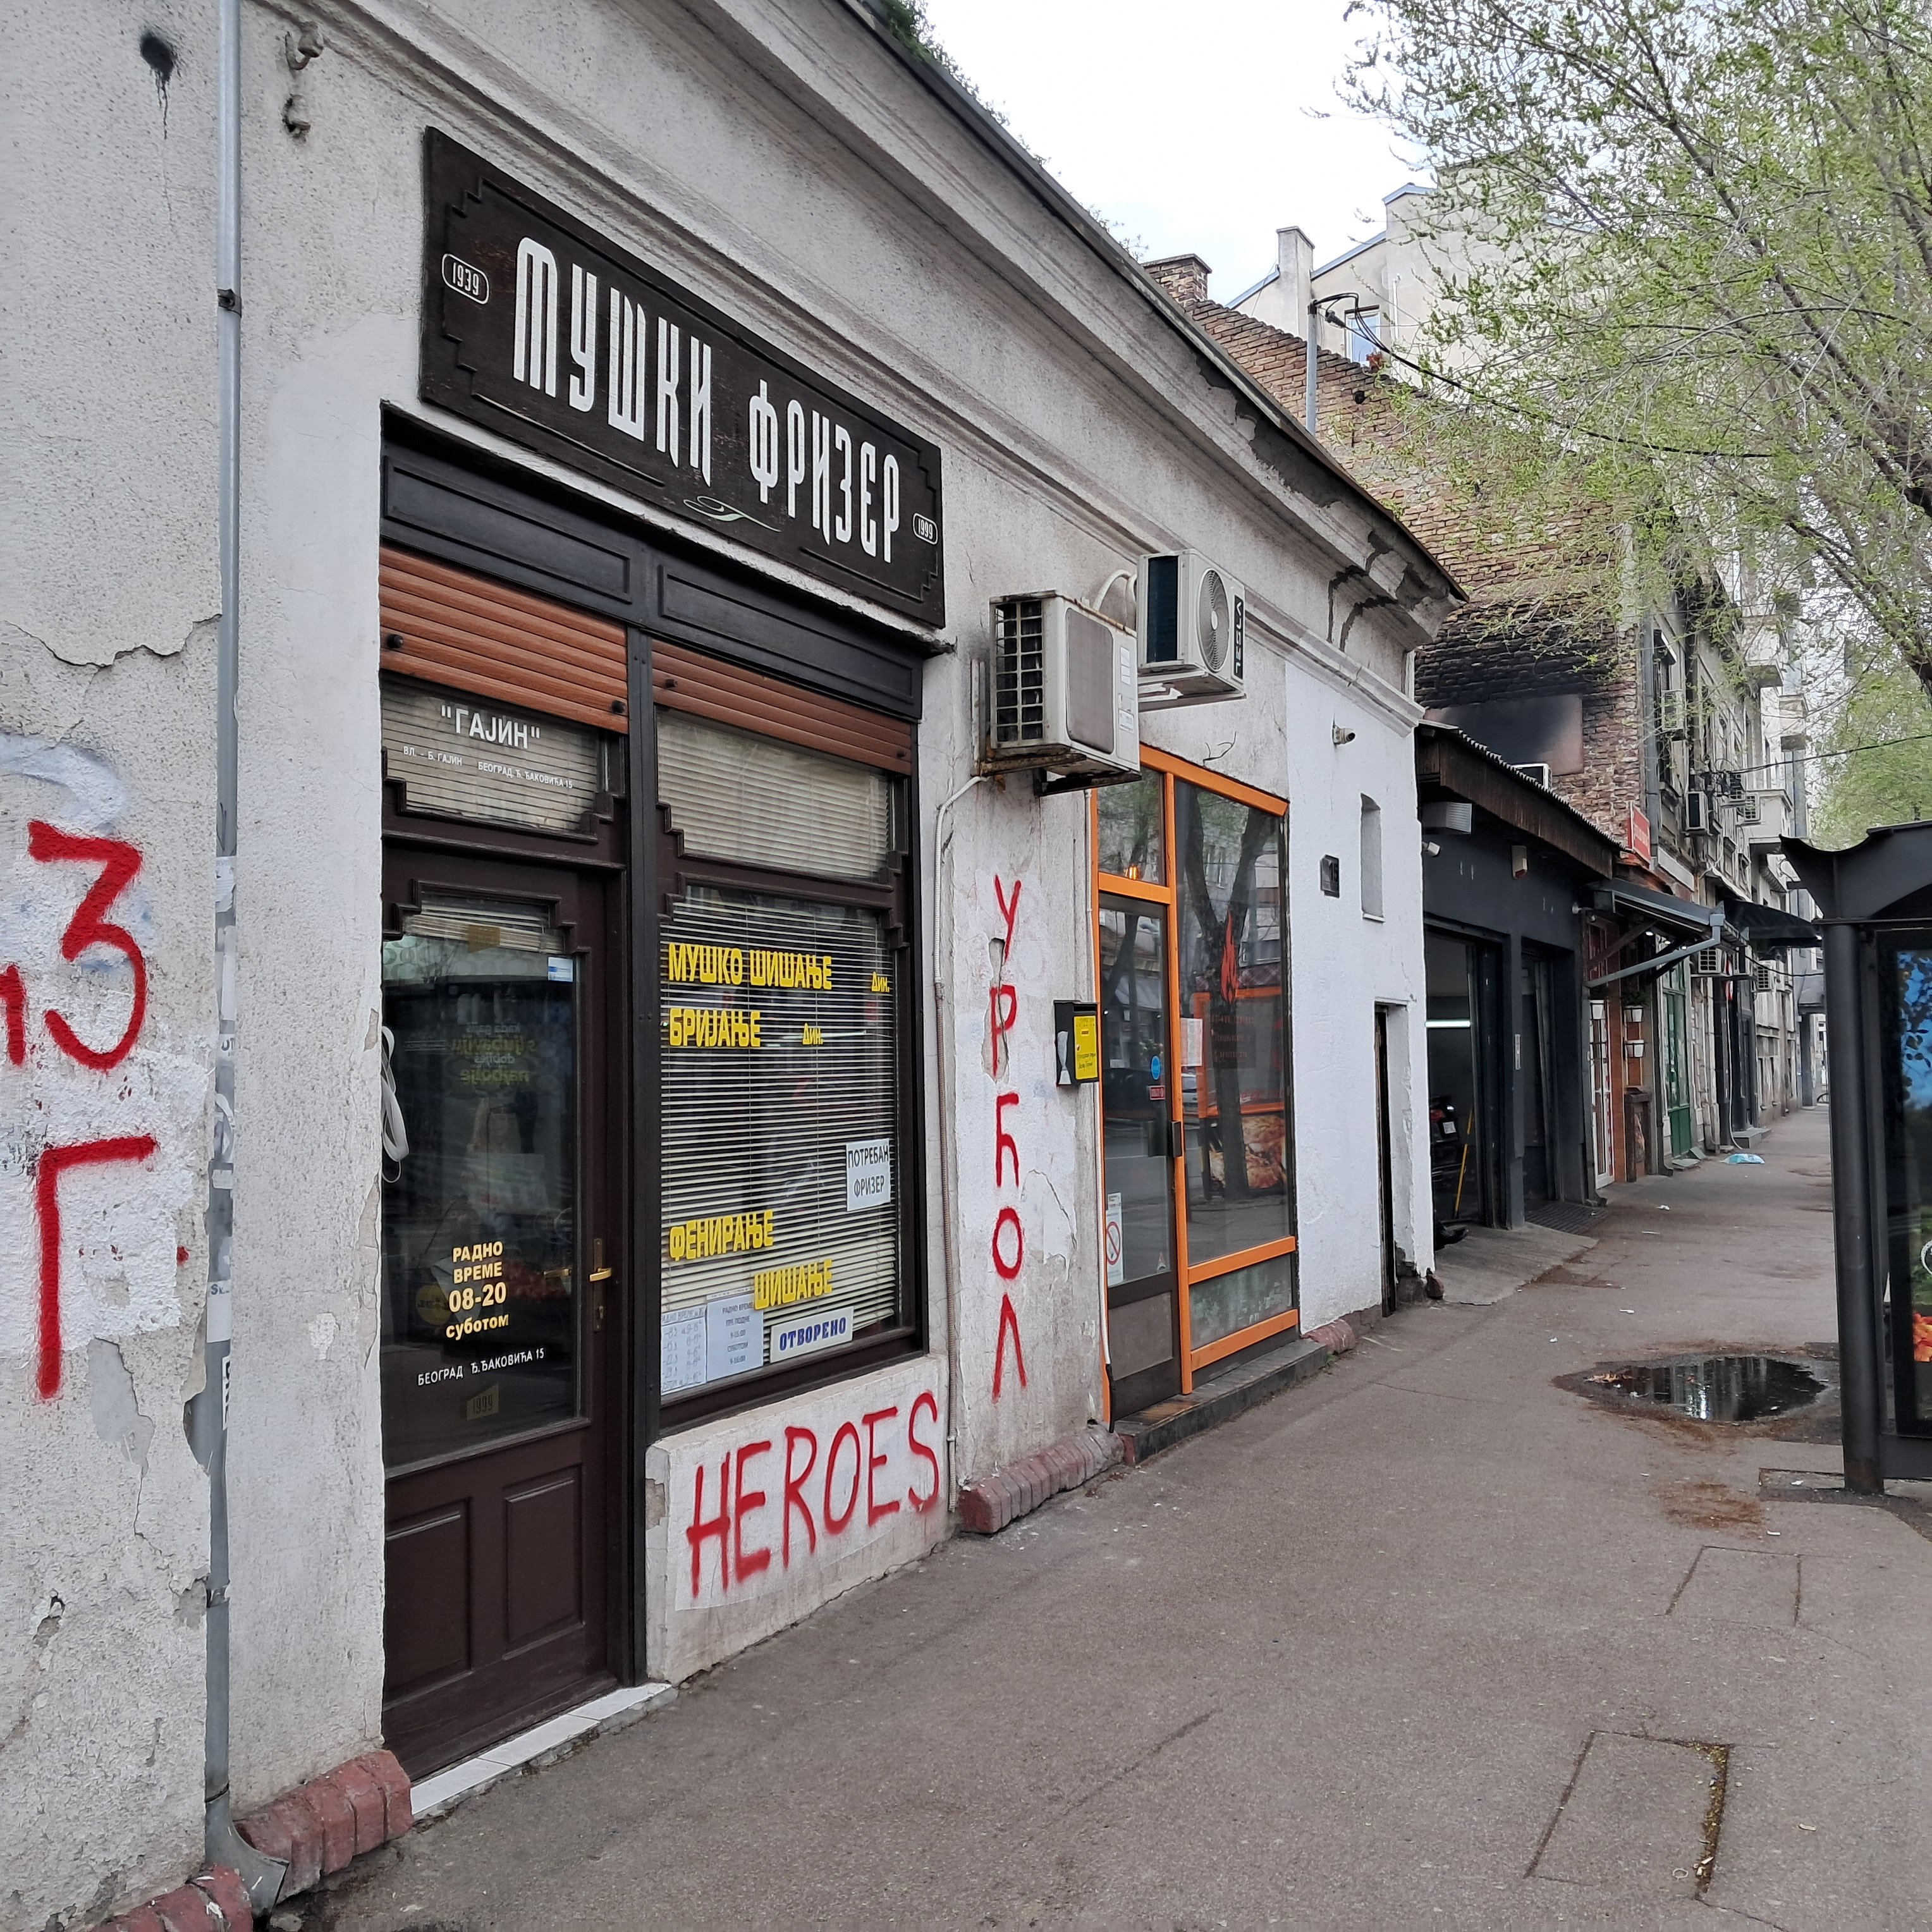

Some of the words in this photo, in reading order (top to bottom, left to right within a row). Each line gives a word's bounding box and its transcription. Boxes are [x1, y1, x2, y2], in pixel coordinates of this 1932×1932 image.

[452, 262, 479, 296] 1939
[513, 236, 712, 487] МУШКИ
[750, 379, 900, 564] ФРИЗЕР
[918, 518, 933, 540] 1999
[441, 705, 540, 749] "ГАЈИН"
[437, 753, 463, 767] ГАЈИН
[477, 761, 514, 779] БЕОГРАД
[565, 780, 573, 789] 15
[668, 943, 743, 986] МУШКО
[749, 949, 833, 990] ШИШАЊЕ
[669, 1007, 761, 1048] БРИЈАЊЕ
[848, 1144, 889, 1168] ПОТРЕБАН
[853, 1175, 884, 1198] ФРИЗЕР
[452, 1241, 503, 1263] РАДНО
[669, 1209, 774, 1261] ФЕНИРАЊЕ
[453, 1262, 503, 1284] ВРЕМЕ
[754, 1259, 833, 1311] ШИШАЊЕ
[449, 1281, 506, 1313] 08-20
[446, 1313, 510, 1340] суботом
[779, 1317, 847, 1352] ОТВОРЕНО
[417, 1365, 464, 1386] БЕОГРАД
[535, 1347, 544, 1359] 15
[472, 1393, 493, 1415] 1999
[686, 1390, 939, 1599] HEROES
